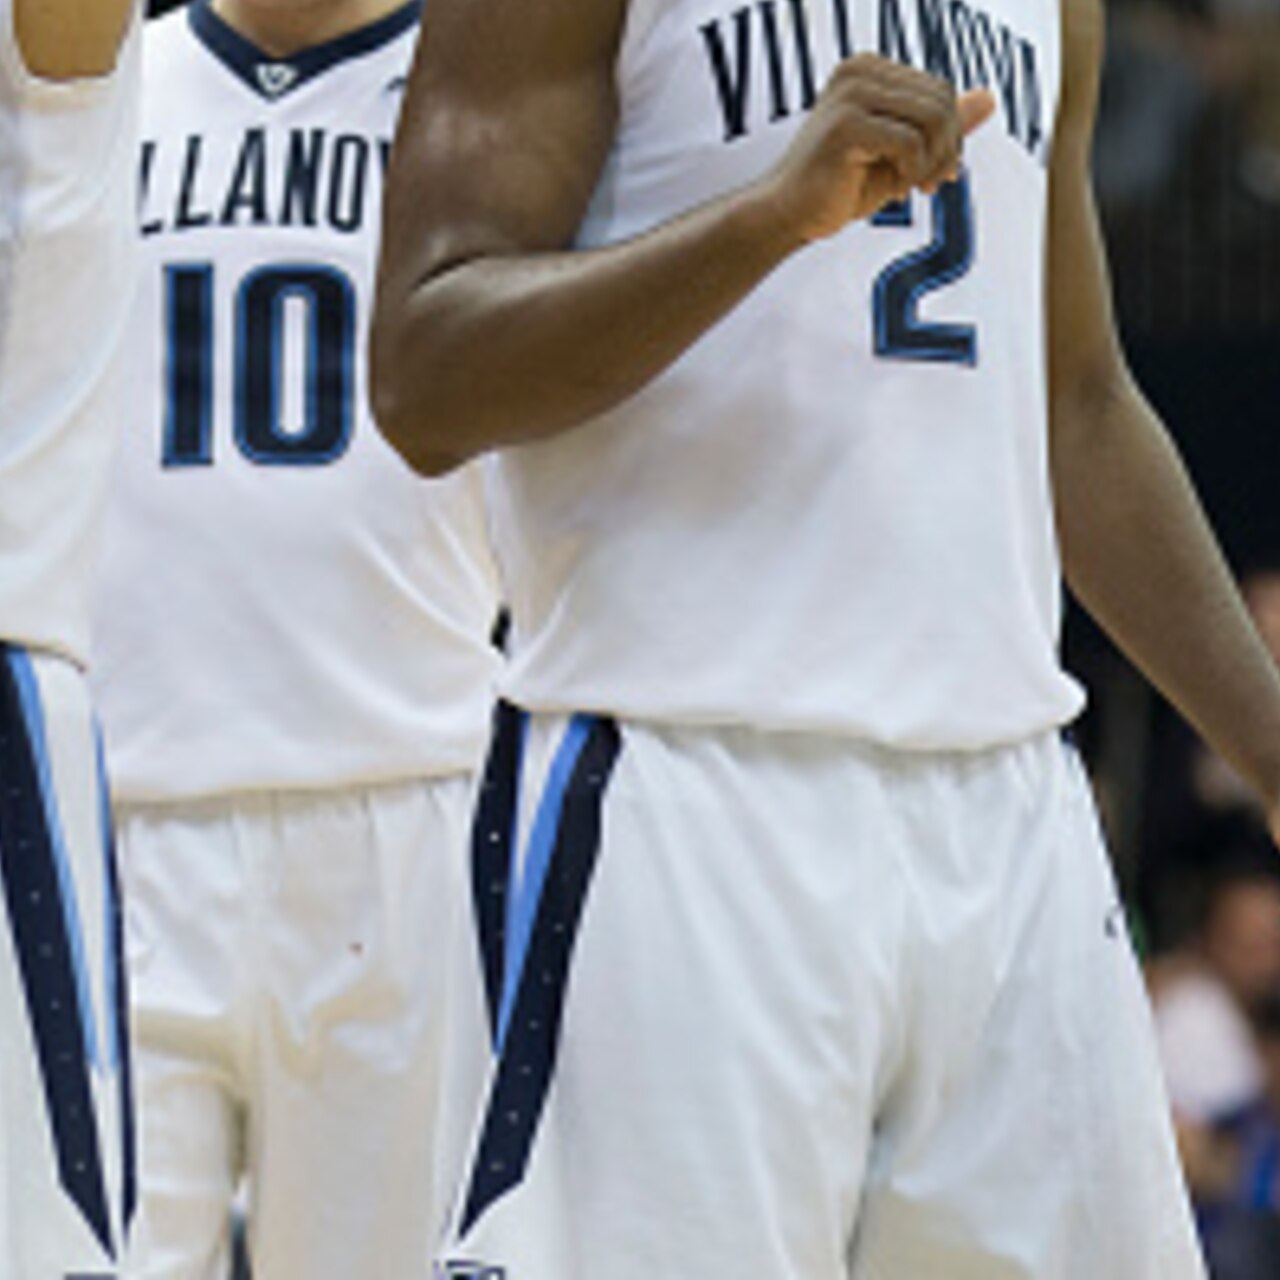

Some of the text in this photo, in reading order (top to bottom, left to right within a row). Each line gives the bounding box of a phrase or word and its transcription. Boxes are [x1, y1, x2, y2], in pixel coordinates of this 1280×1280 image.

[139, 125, 391, 237] LLANO
[870, 165, 978, 368] 2
[161, 262, 356, 469] 10
